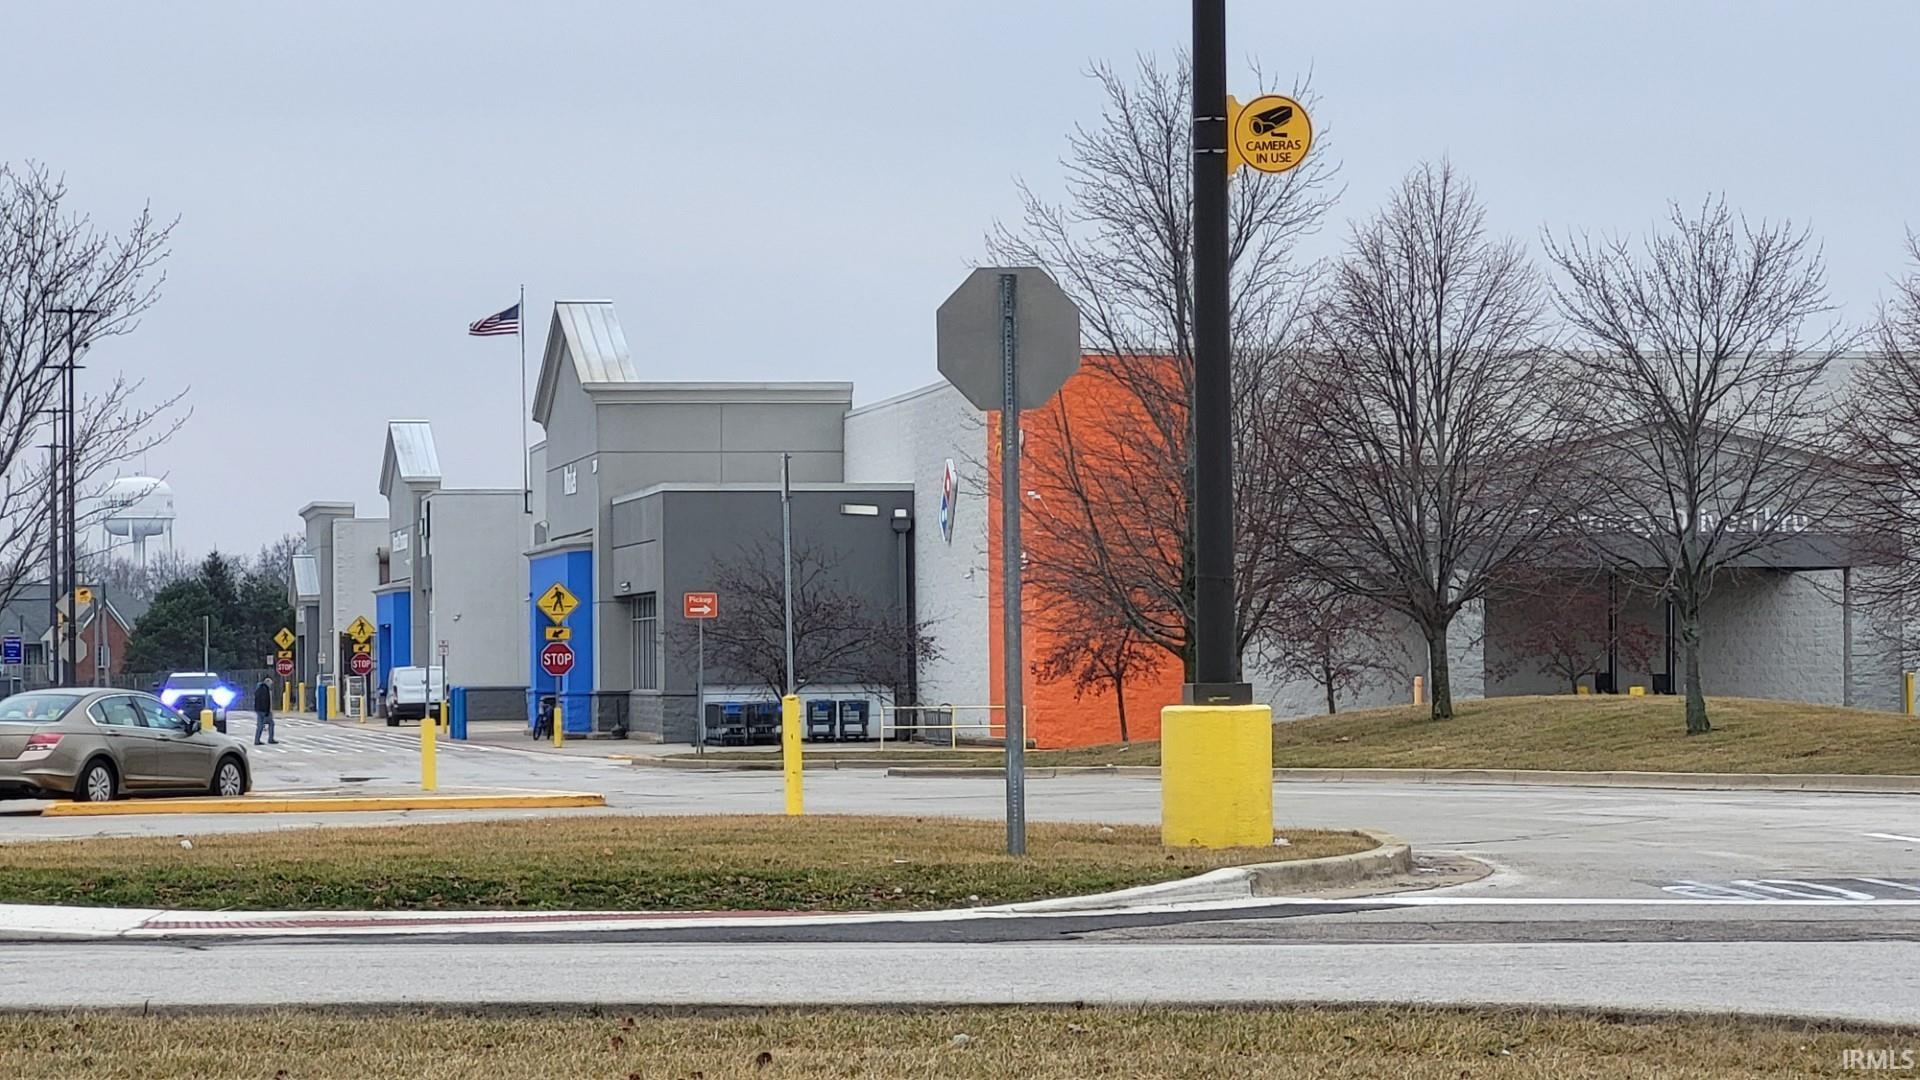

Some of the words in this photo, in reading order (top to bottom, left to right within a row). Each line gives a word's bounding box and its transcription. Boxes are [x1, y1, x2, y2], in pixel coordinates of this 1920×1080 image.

[1246, 140, 1301, 151] CAMERAS
[1256, 153, 1268, 163] IN
[1271, 152, 1291, 163] USE
[1668, 507, 1809, 533] Dive-Thru
[353, 660, 371, 668] STOP
[543, 653, 572, 665] STOP
